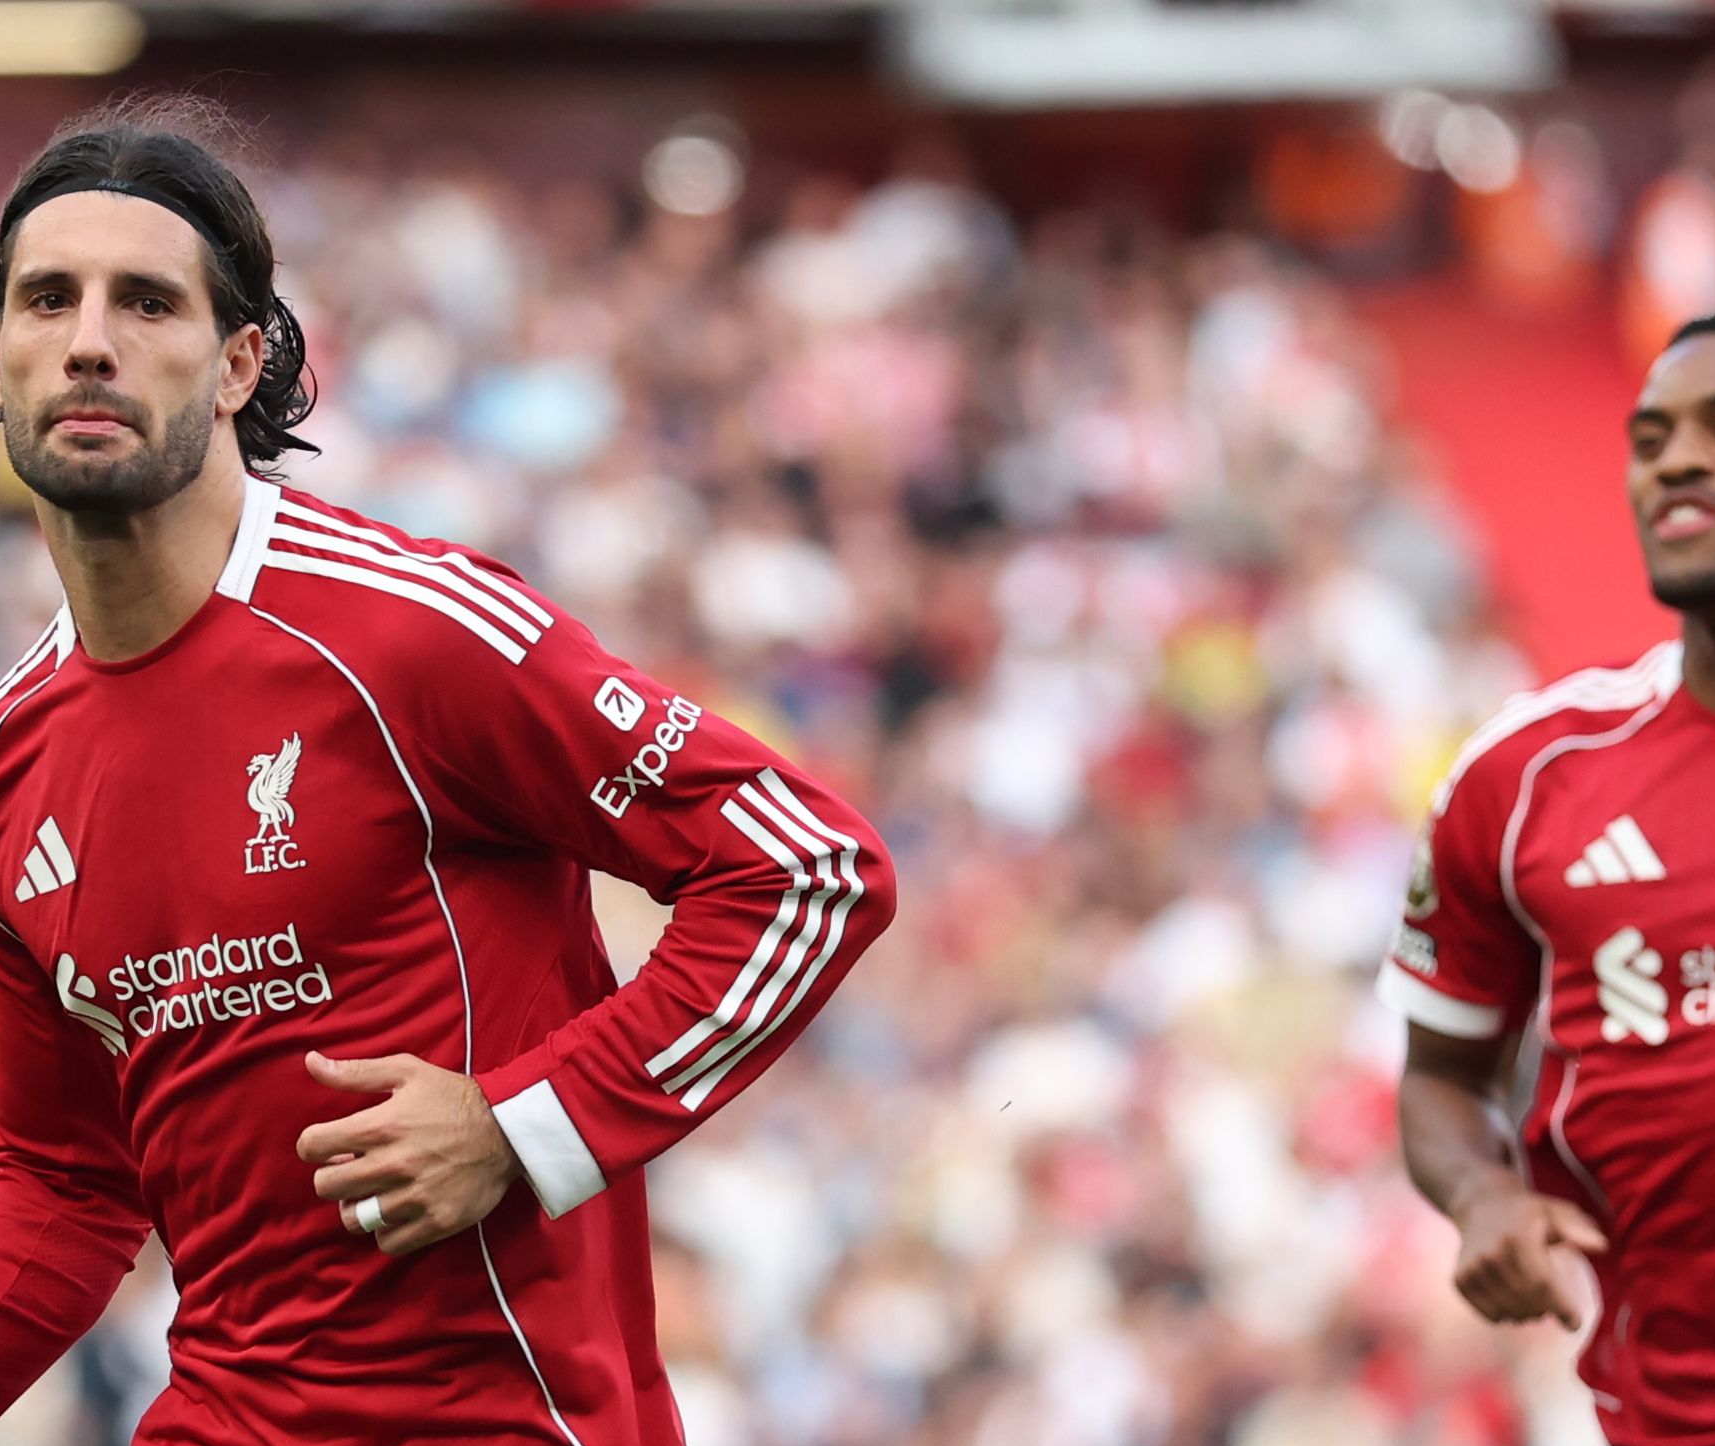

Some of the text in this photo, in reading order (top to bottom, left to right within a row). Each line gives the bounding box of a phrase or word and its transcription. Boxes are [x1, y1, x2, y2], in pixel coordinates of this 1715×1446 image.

[244, 842, 307, 874] L.F.C.
[108, 922, 305, 1001] standard
[127, 962, 333, 1039] chartered
